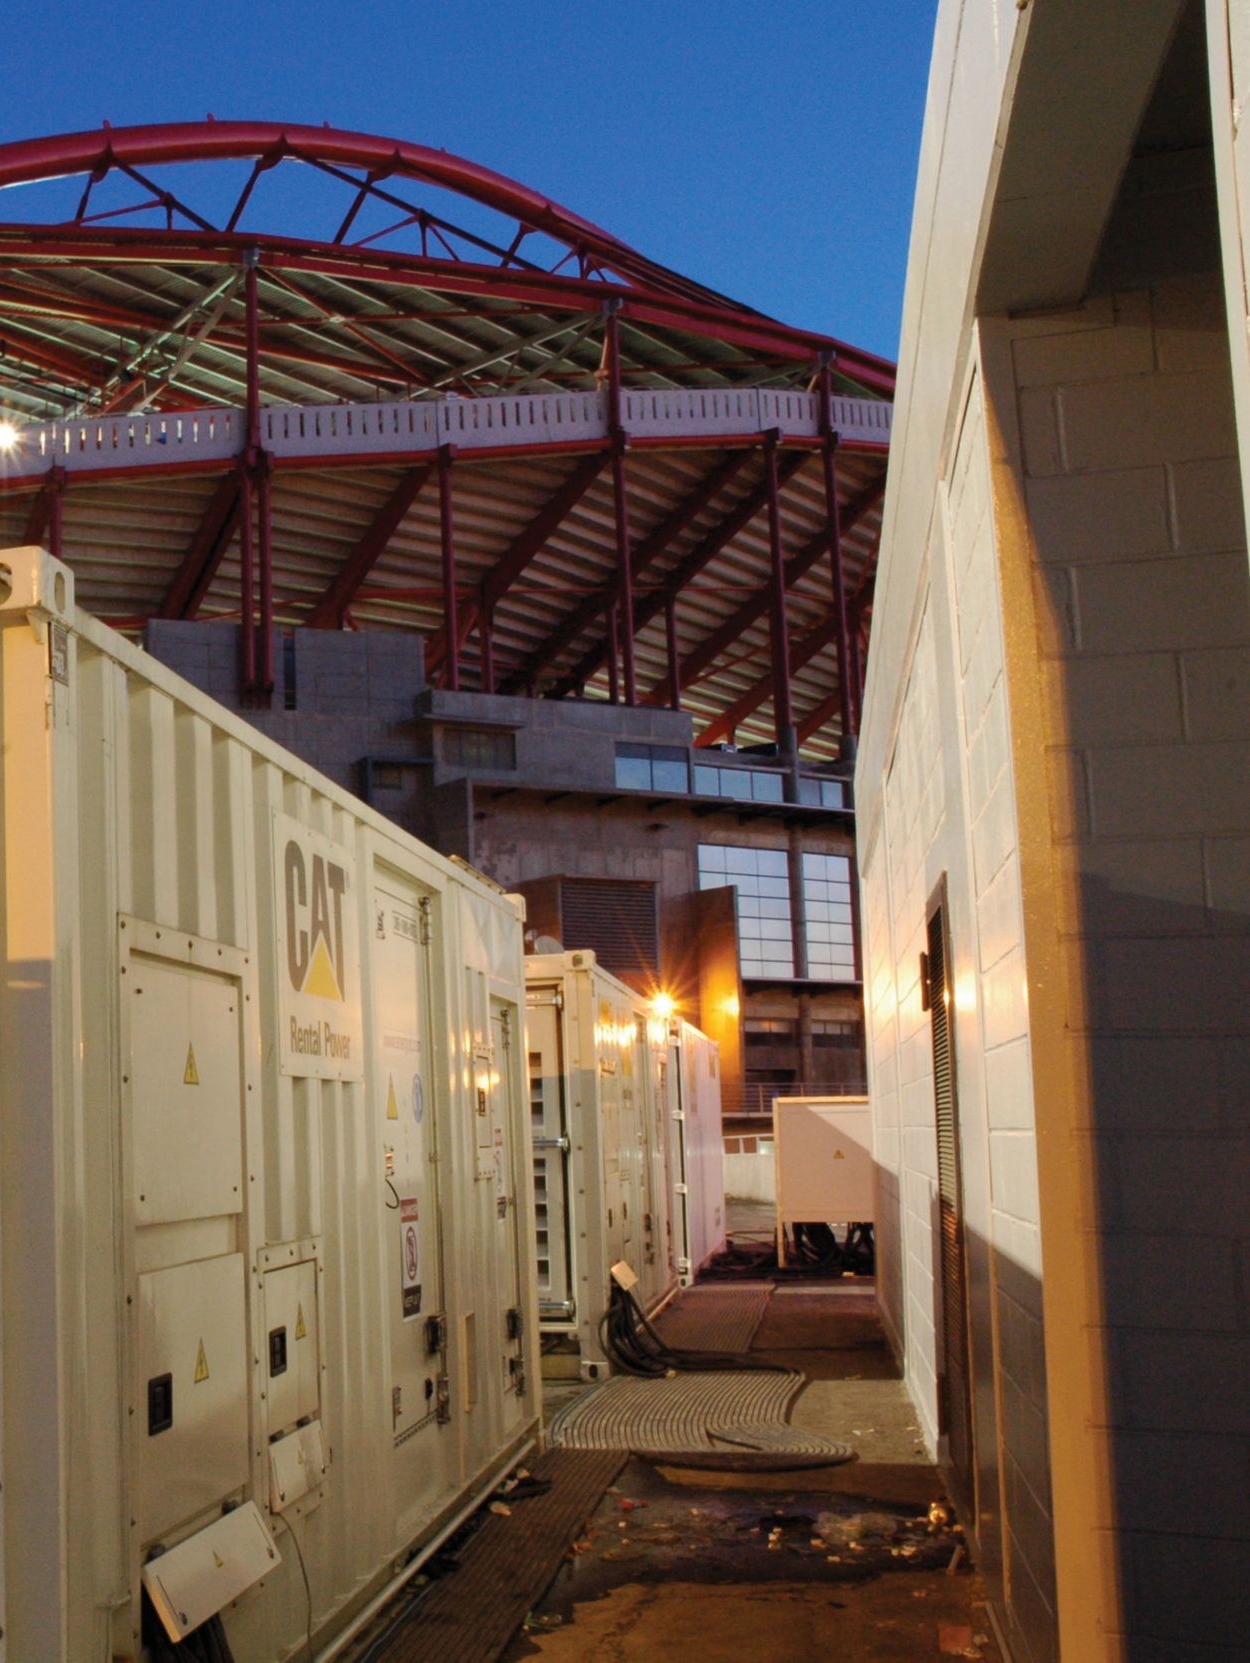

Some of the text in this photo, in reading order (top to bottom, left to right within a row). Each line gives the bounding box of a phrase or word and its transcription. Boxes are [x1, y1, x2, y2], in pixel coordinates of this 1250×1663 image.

[285, 840, 346, 1002] CAT
[290, 1015, 321, 1057] Rental
[324, 1021, 350, 1060] Power
